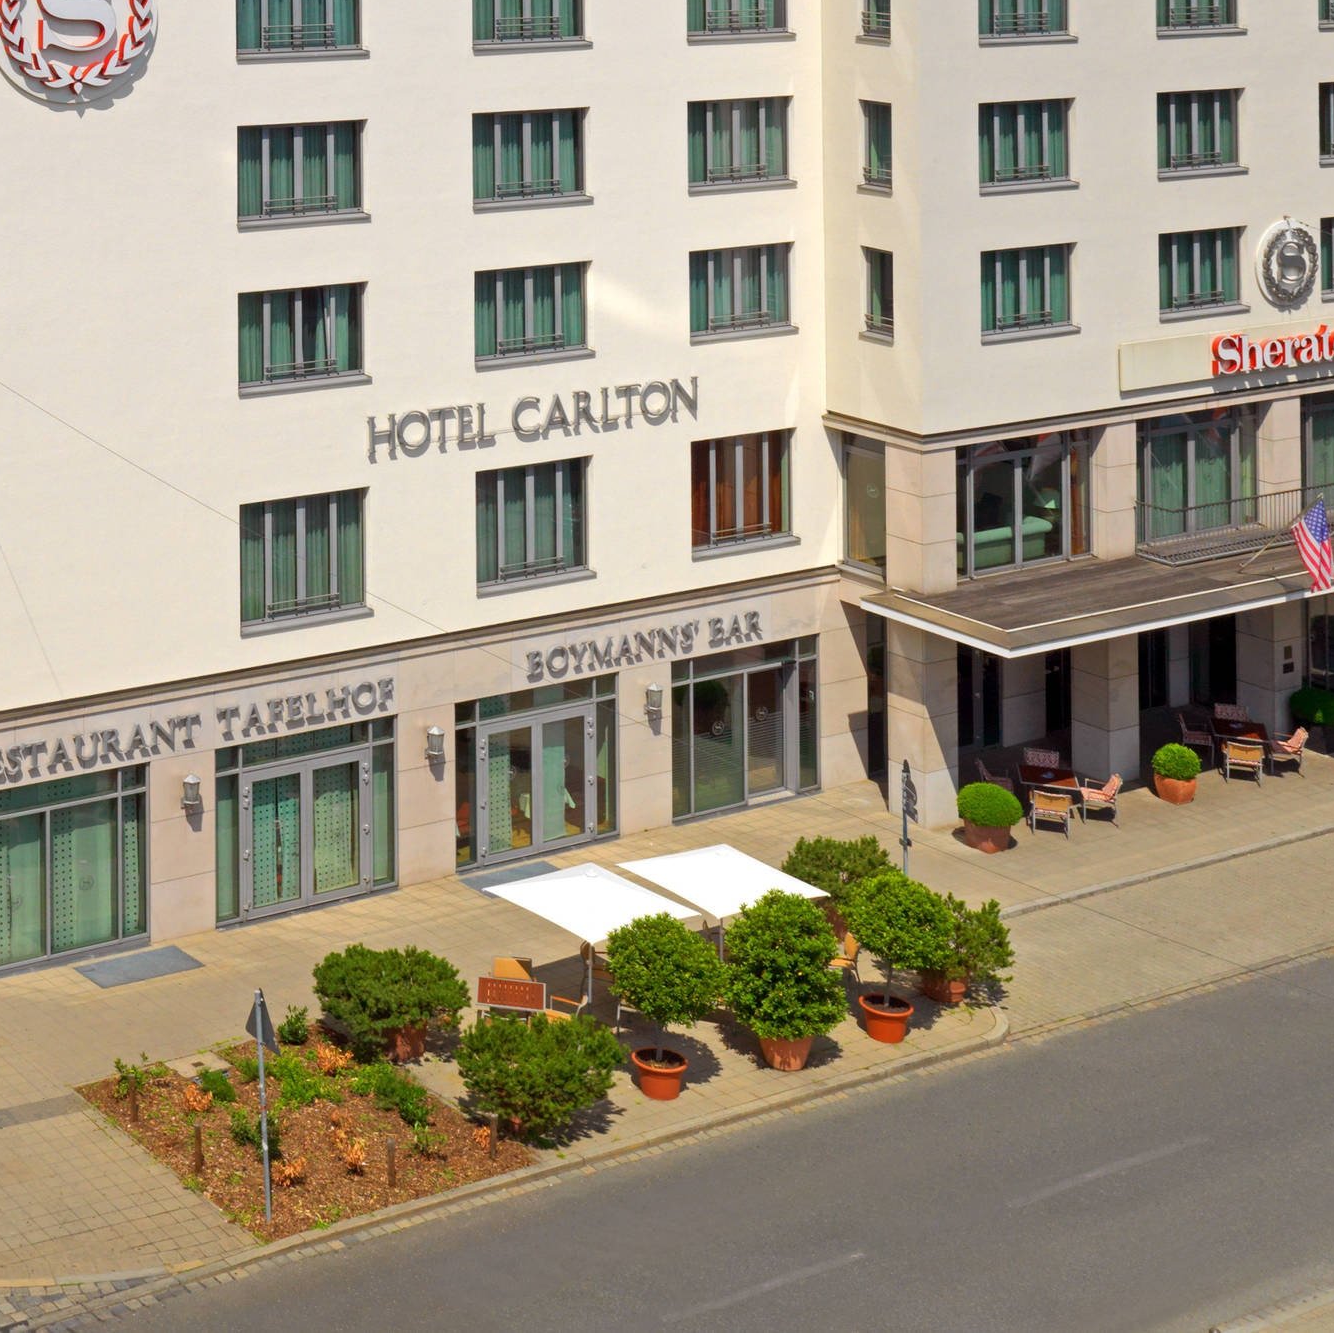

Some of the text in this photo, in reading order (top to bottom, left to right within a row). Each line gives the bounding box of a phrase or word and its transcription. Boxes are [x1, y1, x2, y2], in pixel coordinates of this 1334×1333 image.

[367, 376, 699, 460] HOTEL CARLTON
[526, 611, 763, 678] BOYMANNS' BAR
[216, 677, 394, 736] TAFELHOF
